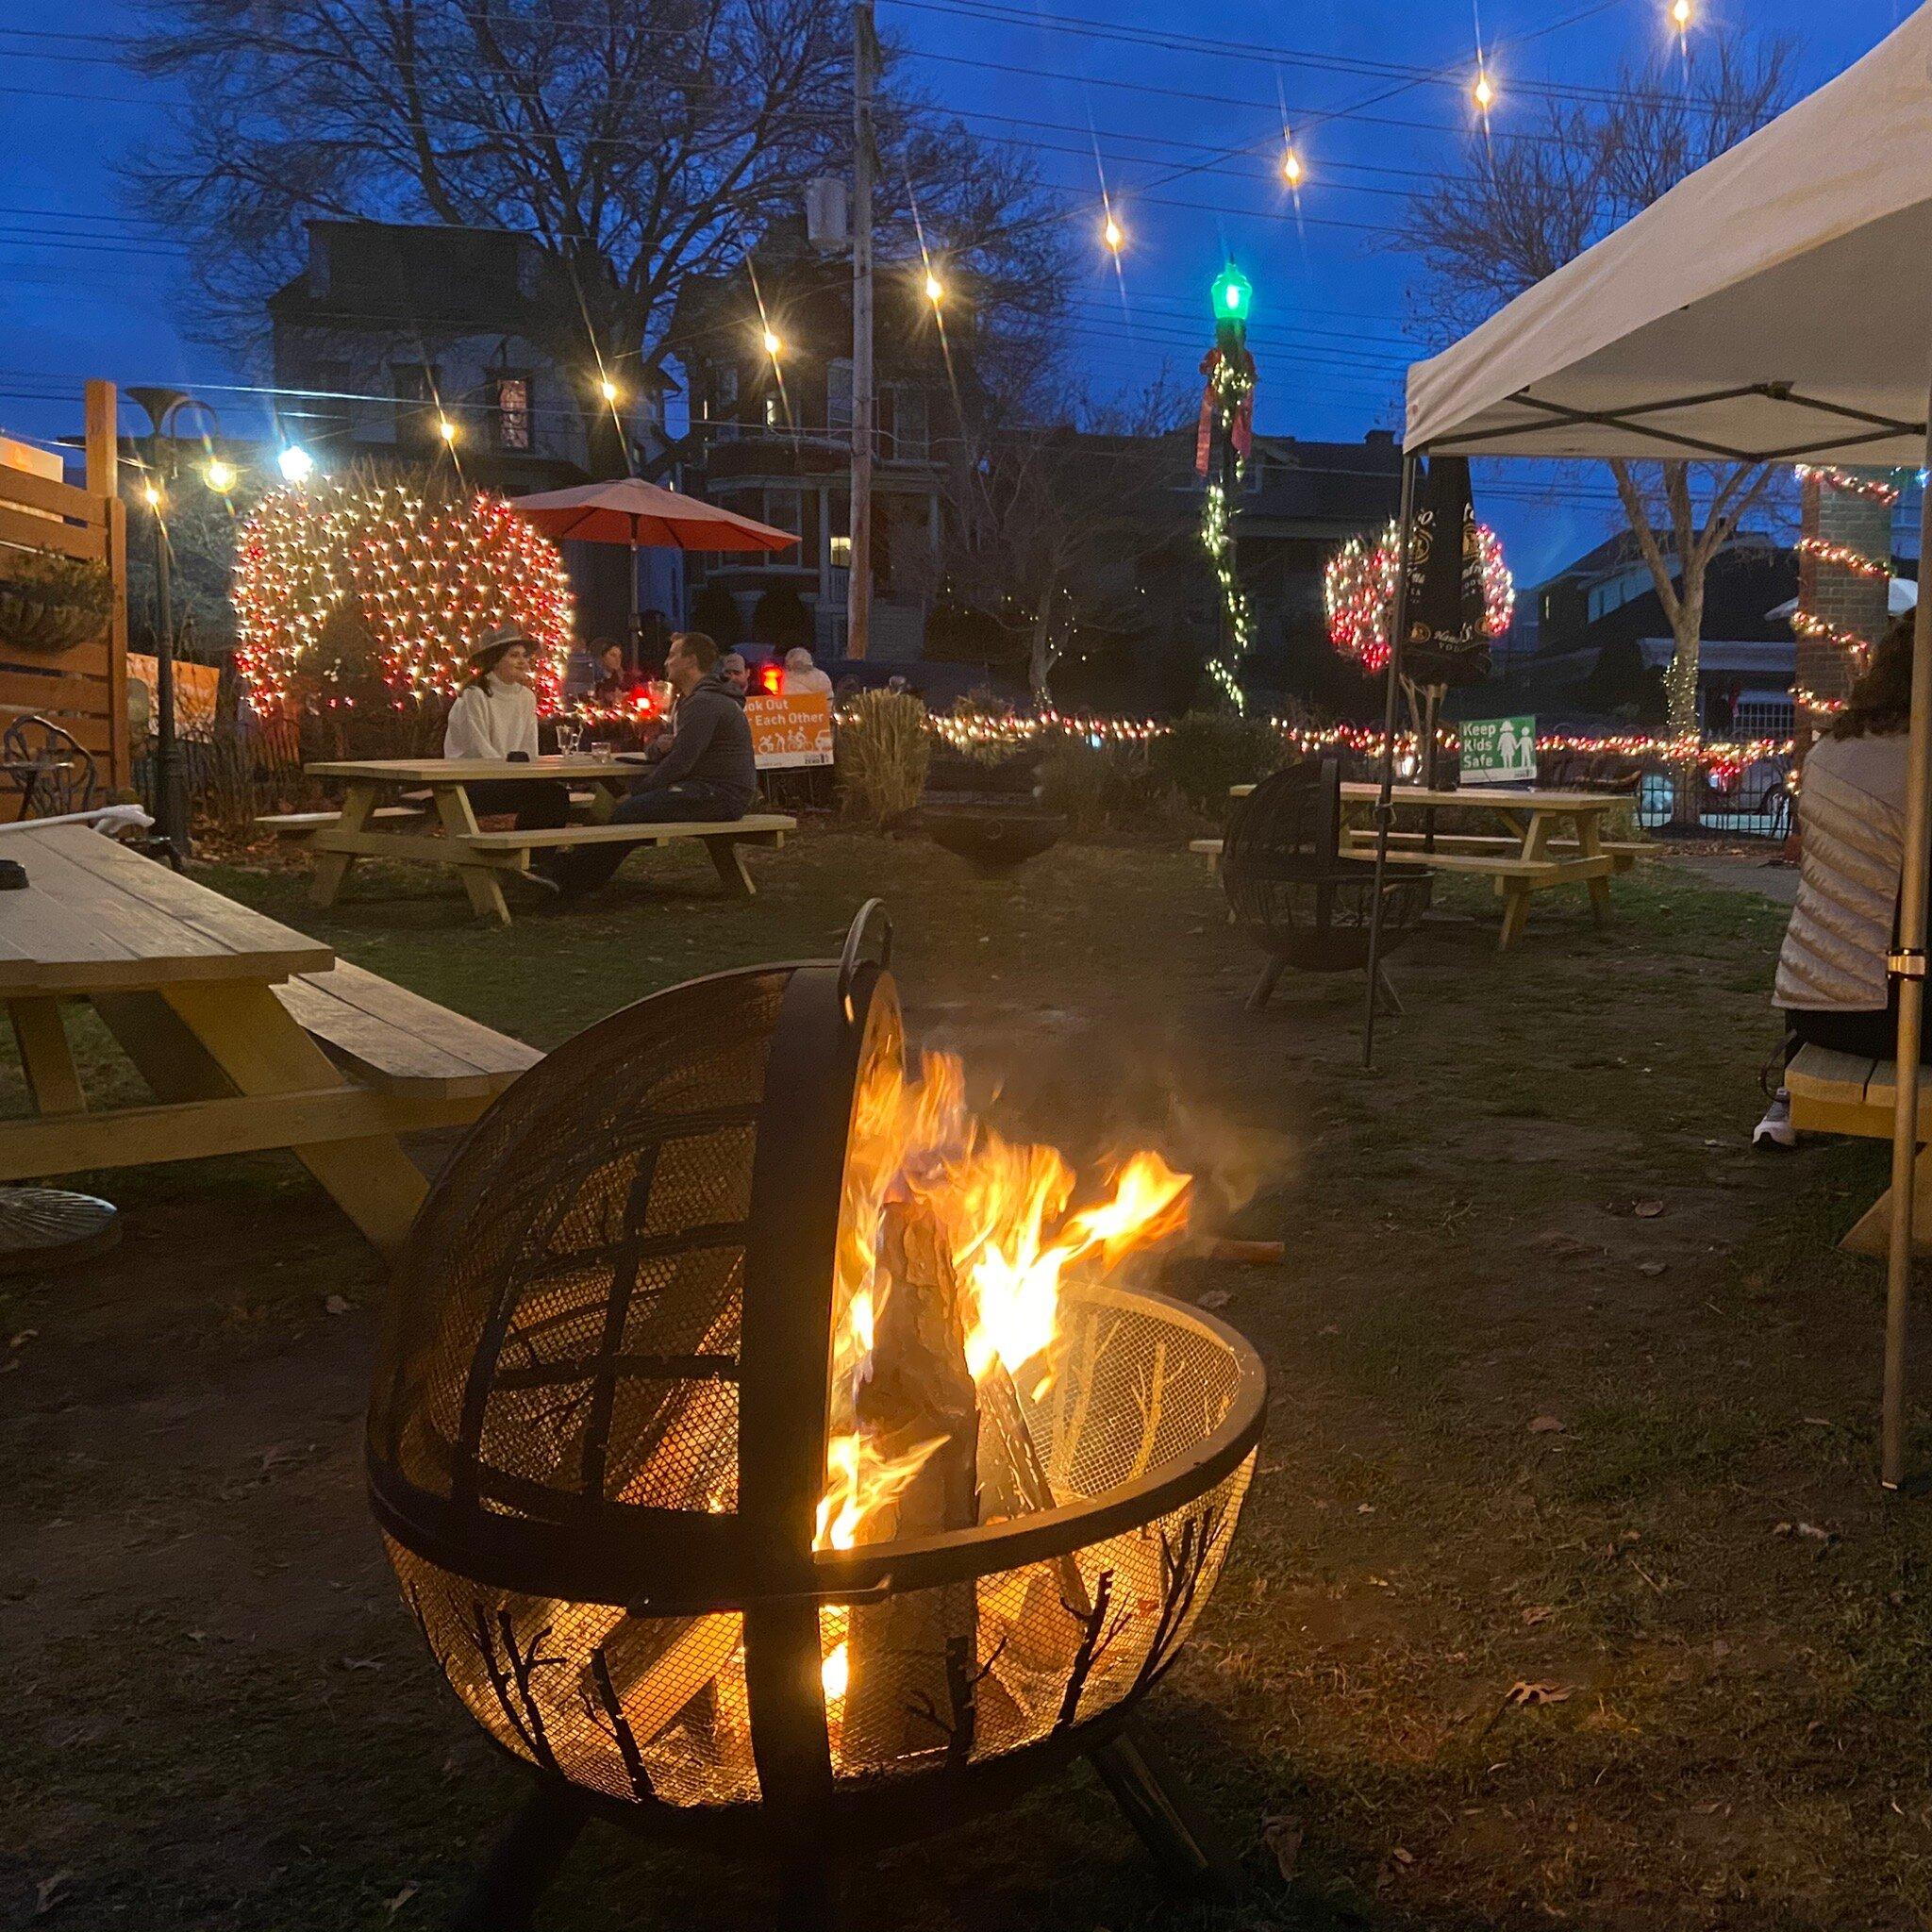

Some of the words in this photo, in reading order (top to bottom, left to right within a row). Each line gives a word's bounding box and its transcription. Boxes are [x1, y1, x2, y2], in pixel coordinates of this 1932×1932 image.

[766, 699, 789, 710] Out
[755, 714, 786, 726] Each
[788, 712, 824, 724] Other
[1462, 723, 1497, 738] Keep
[1463, 738, 1493, 753] Kids
[1463, 754, 1493, 769] Safe
